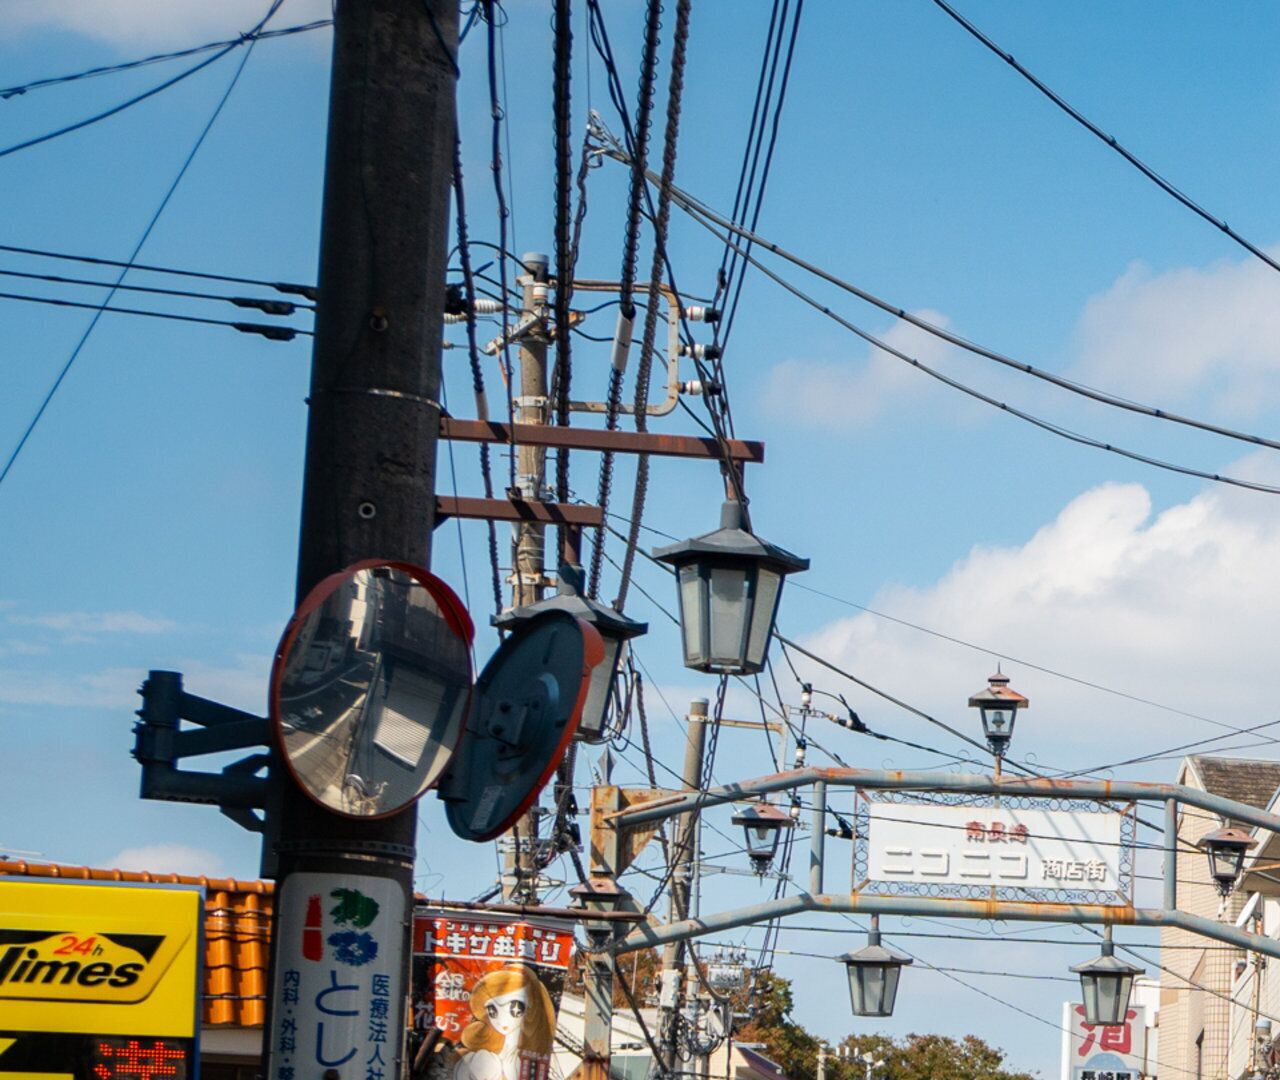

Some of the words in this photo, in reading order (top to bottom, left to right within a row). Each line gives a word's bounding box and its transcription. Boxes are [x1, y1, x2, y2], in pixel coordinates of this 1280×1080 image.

[965, 820, 1030, 845] 南長崎
[1042, 858, 1107, 882] 商店街
[53, 936, 103, 957] 24h
